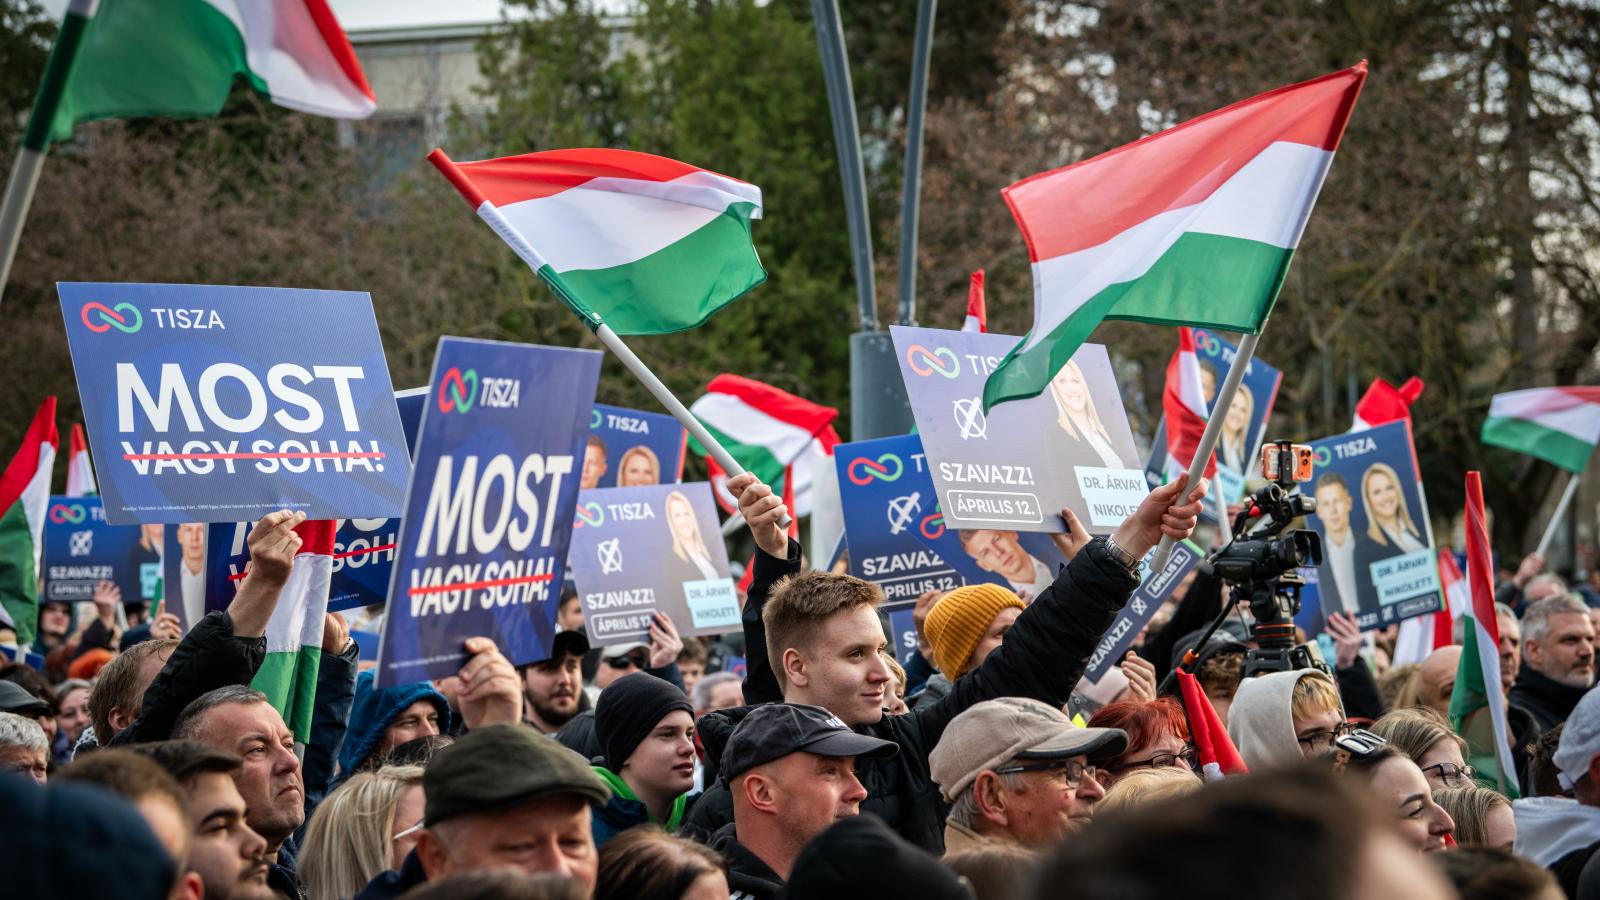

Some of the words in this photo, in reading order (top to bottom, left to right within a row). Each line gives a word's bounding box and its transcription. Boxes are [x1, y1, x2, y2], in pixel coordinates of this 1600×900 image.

[151, 308, 225, 329] TISZA
[116, 362, 365, 433] MOST
[480, 377, 520, 408] TISZA
[607, 415, 650, 435] TISZA
[121, 441, 239, 475] VAGY
[252, 440, 385, 473] SOHA!
[1334, 437, 1378, 459] TISZA
[939, 462, 1035, 485] SZAVAZZ!
[1083, 476, 1104, 489] DR.
[1106, 474, 1142, 491] ÁRVAY
[415, 453, 574, 558] MOST
[608, 503, 655, 521] TISZA
[957, 494, 1014, 515] ÁPRILIS
[1015, 500, 1036, 516] 12.
[410, 563, 481, 617] VAGY
[480, 557, 555, 609] SOHA!
[1150, 563, 1176, 594] ÁPRILIS
[586, 588, 656, 610] SZAVAZZ!
[689, 588, 704, 599] DR.
[705, 585, 731, 598] ÁRVAY
[696, 606, 735, 619] NIKOLETT
[597, 616, 640, 633] ÁPRILIS
[1086, 616, 1133, 672] SZAVAZZ!
